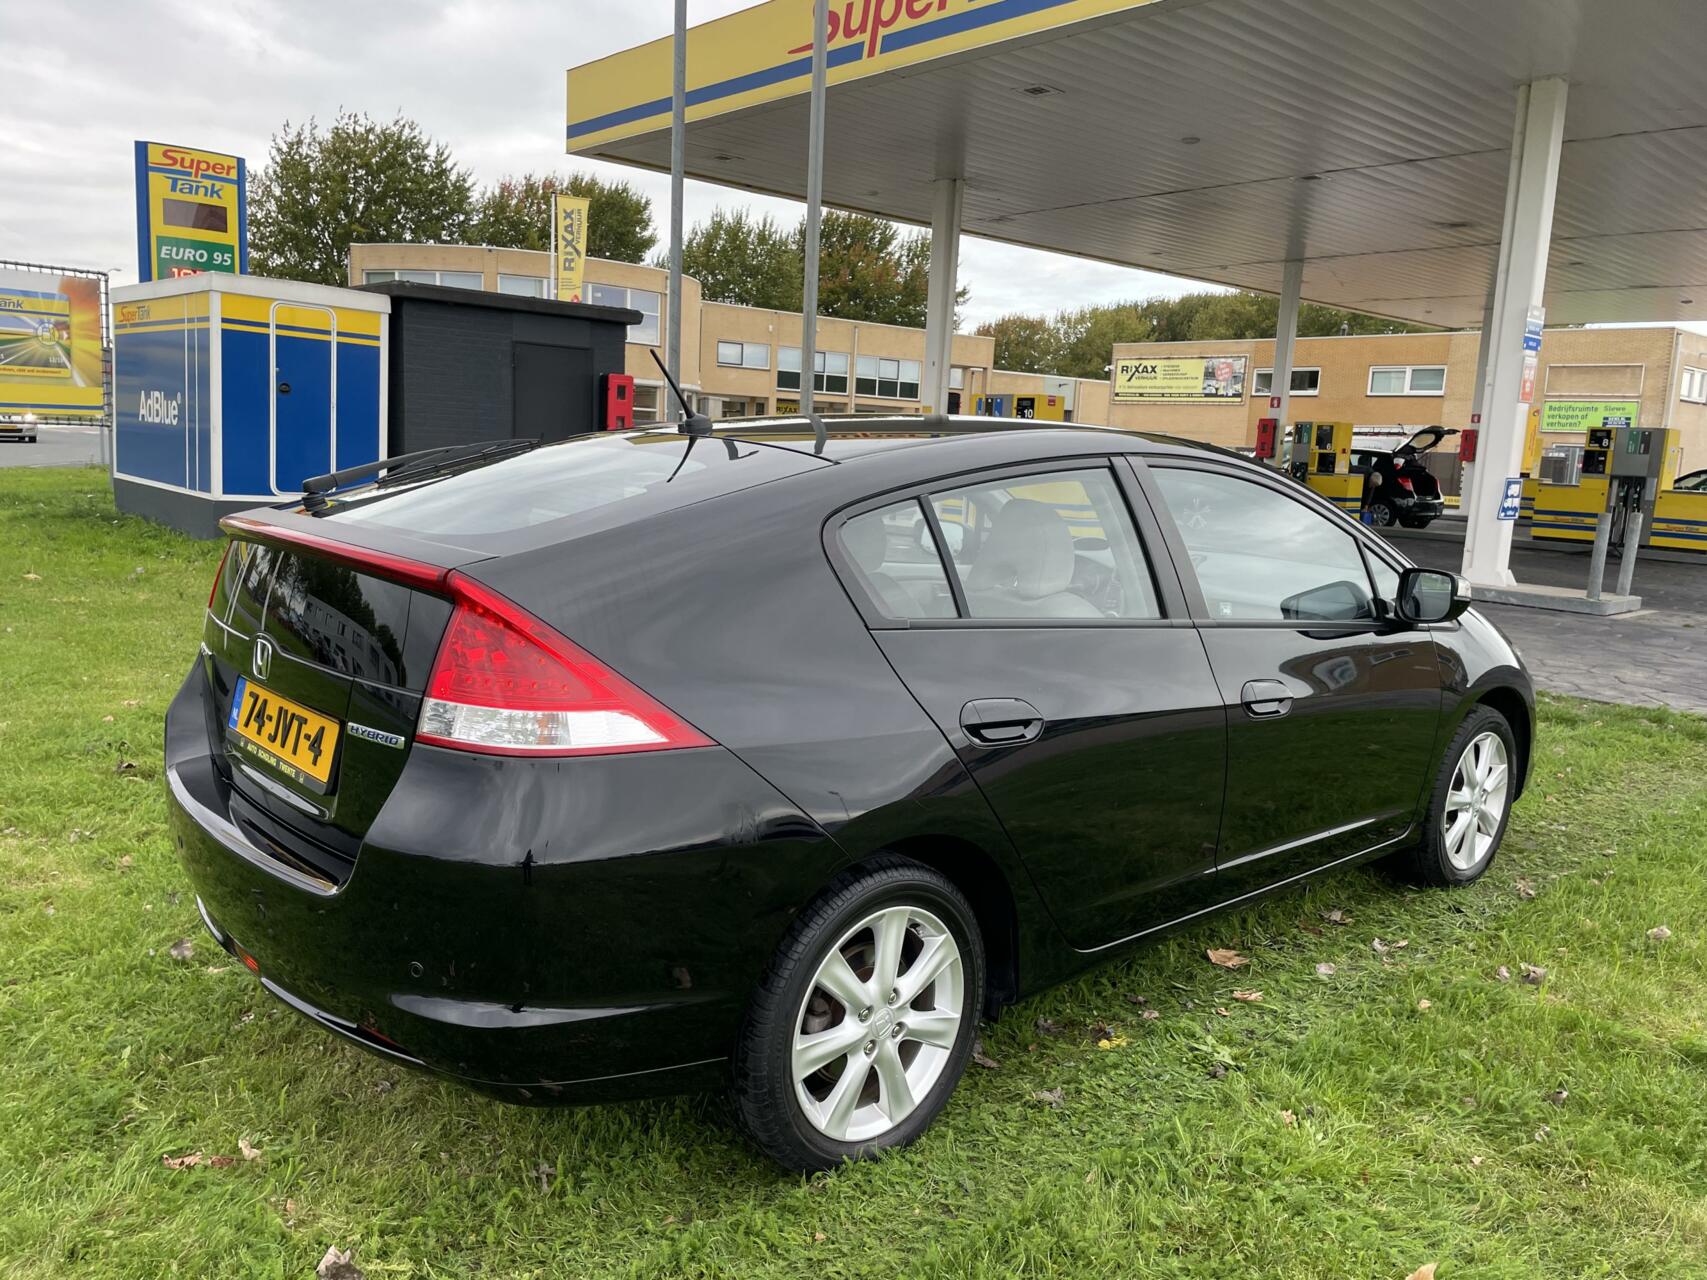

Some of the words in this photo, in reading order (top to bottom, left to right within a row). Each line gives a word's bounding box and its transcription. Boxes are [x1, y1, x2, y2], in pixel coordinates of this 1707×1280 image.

[787, 0, 949, 59] Supe
[149, 148, 236, 178] Super
[163, 175, 223, 200] Tank
[160, 245, 208, 262] EURO
[212, 251, 232, 266] 95
[1023, 408, 1034, 418] 10
[1547, 413, 1579, 421] verkopen
[1548, 405, 1599, 413] Bedrijfsruimte
[1601, 438, 1609, 447] 8
[243, 690, 326, 767] 74-JVT-4
[350, 725, 399, 746] HYBRID
